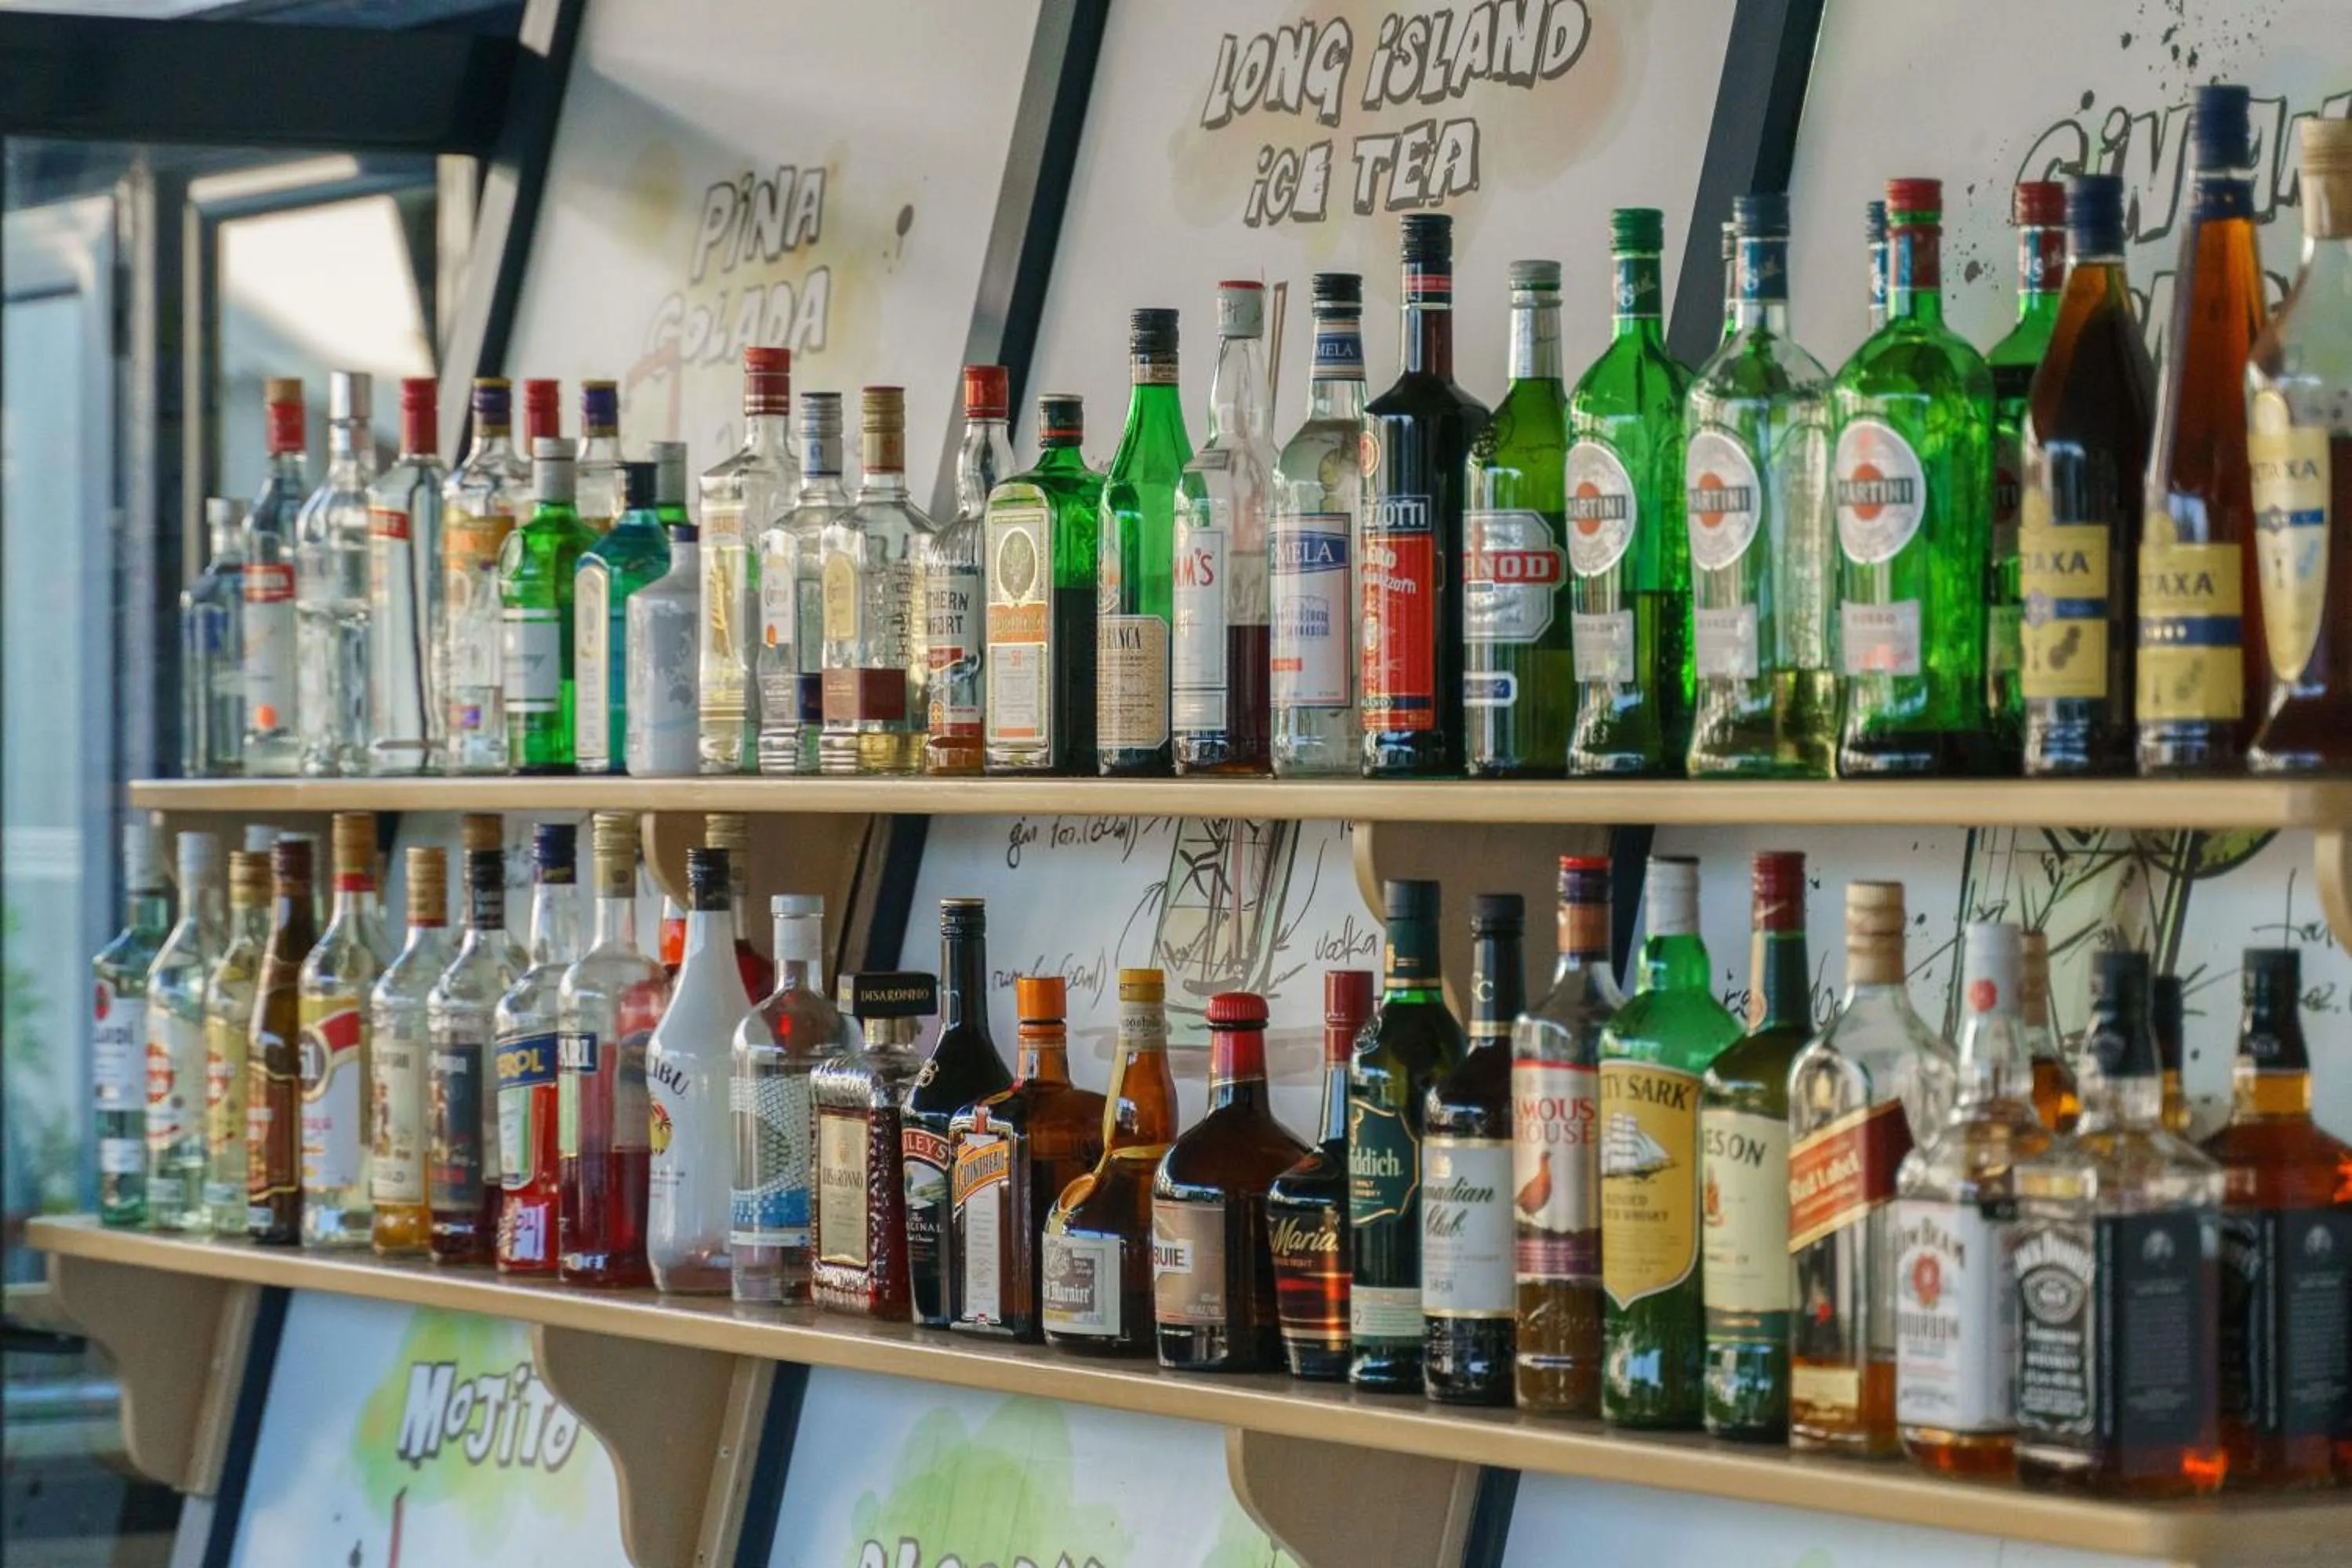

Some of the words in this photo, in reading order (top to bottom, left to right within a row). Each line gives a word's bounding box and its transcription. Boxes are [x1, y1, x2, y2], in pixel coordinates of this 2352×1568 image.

[1200, 16, 1352, 129] LONG
[1352, 118, 1480, 214] TEA
[860, 989, 930, 1003] DISARONNO
[1627, 1074, 1691, 1112] SARK
[1267, 1216, 1339, 1257] Maria
